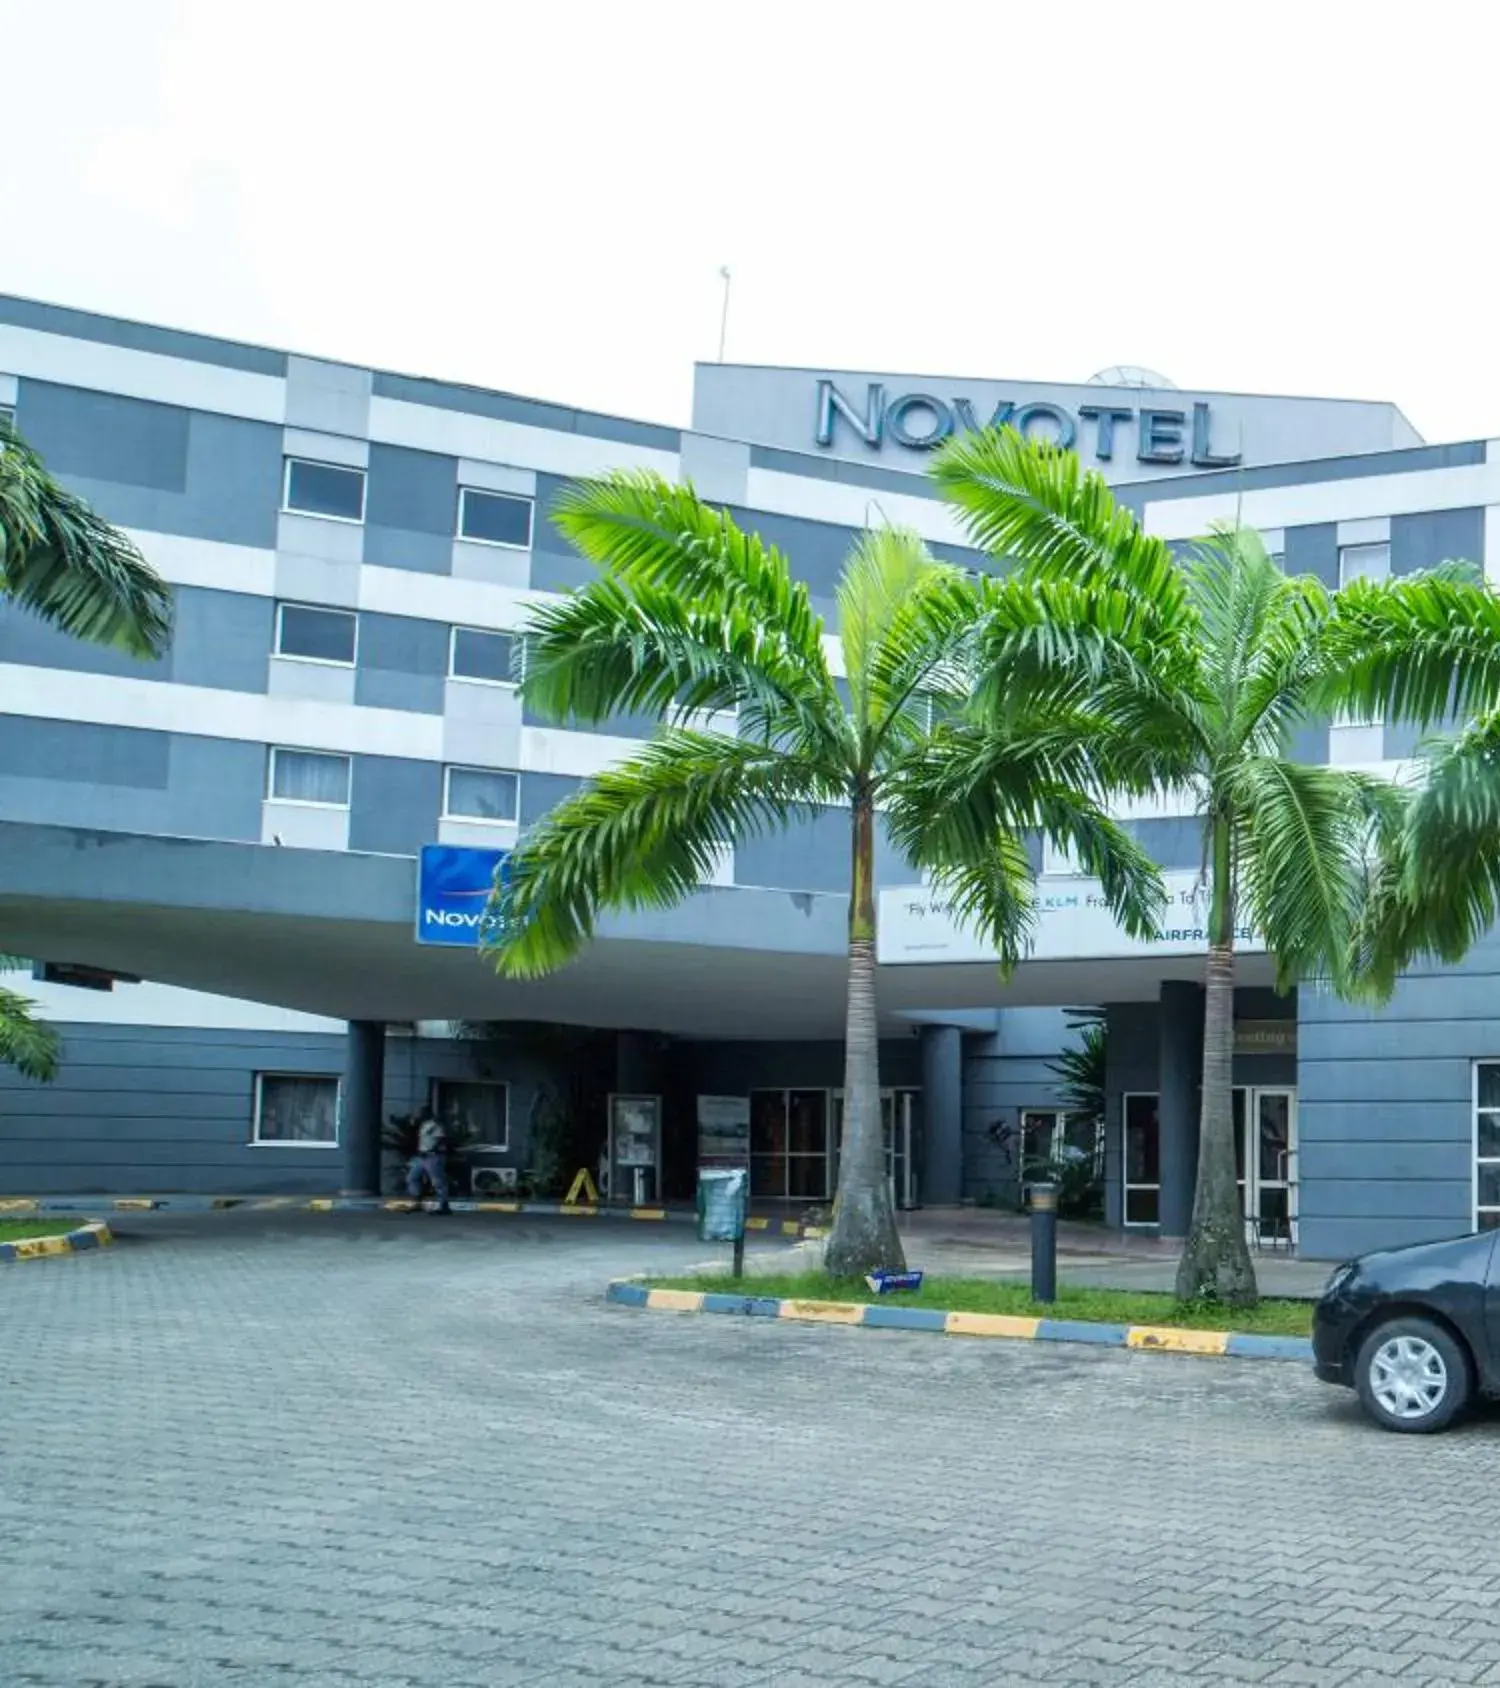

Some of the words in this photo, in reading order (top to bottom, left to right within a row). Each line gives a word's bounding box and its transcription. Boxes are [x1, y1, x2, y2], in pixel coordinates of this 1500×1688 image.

[815, 379, 1242, 468] NOVOTEL
[1045, 896, 1078, 908] KLM
[425, 908, 530, 928] NOVOTL
[1154, 927, 1251, 942] AIRFRCE
